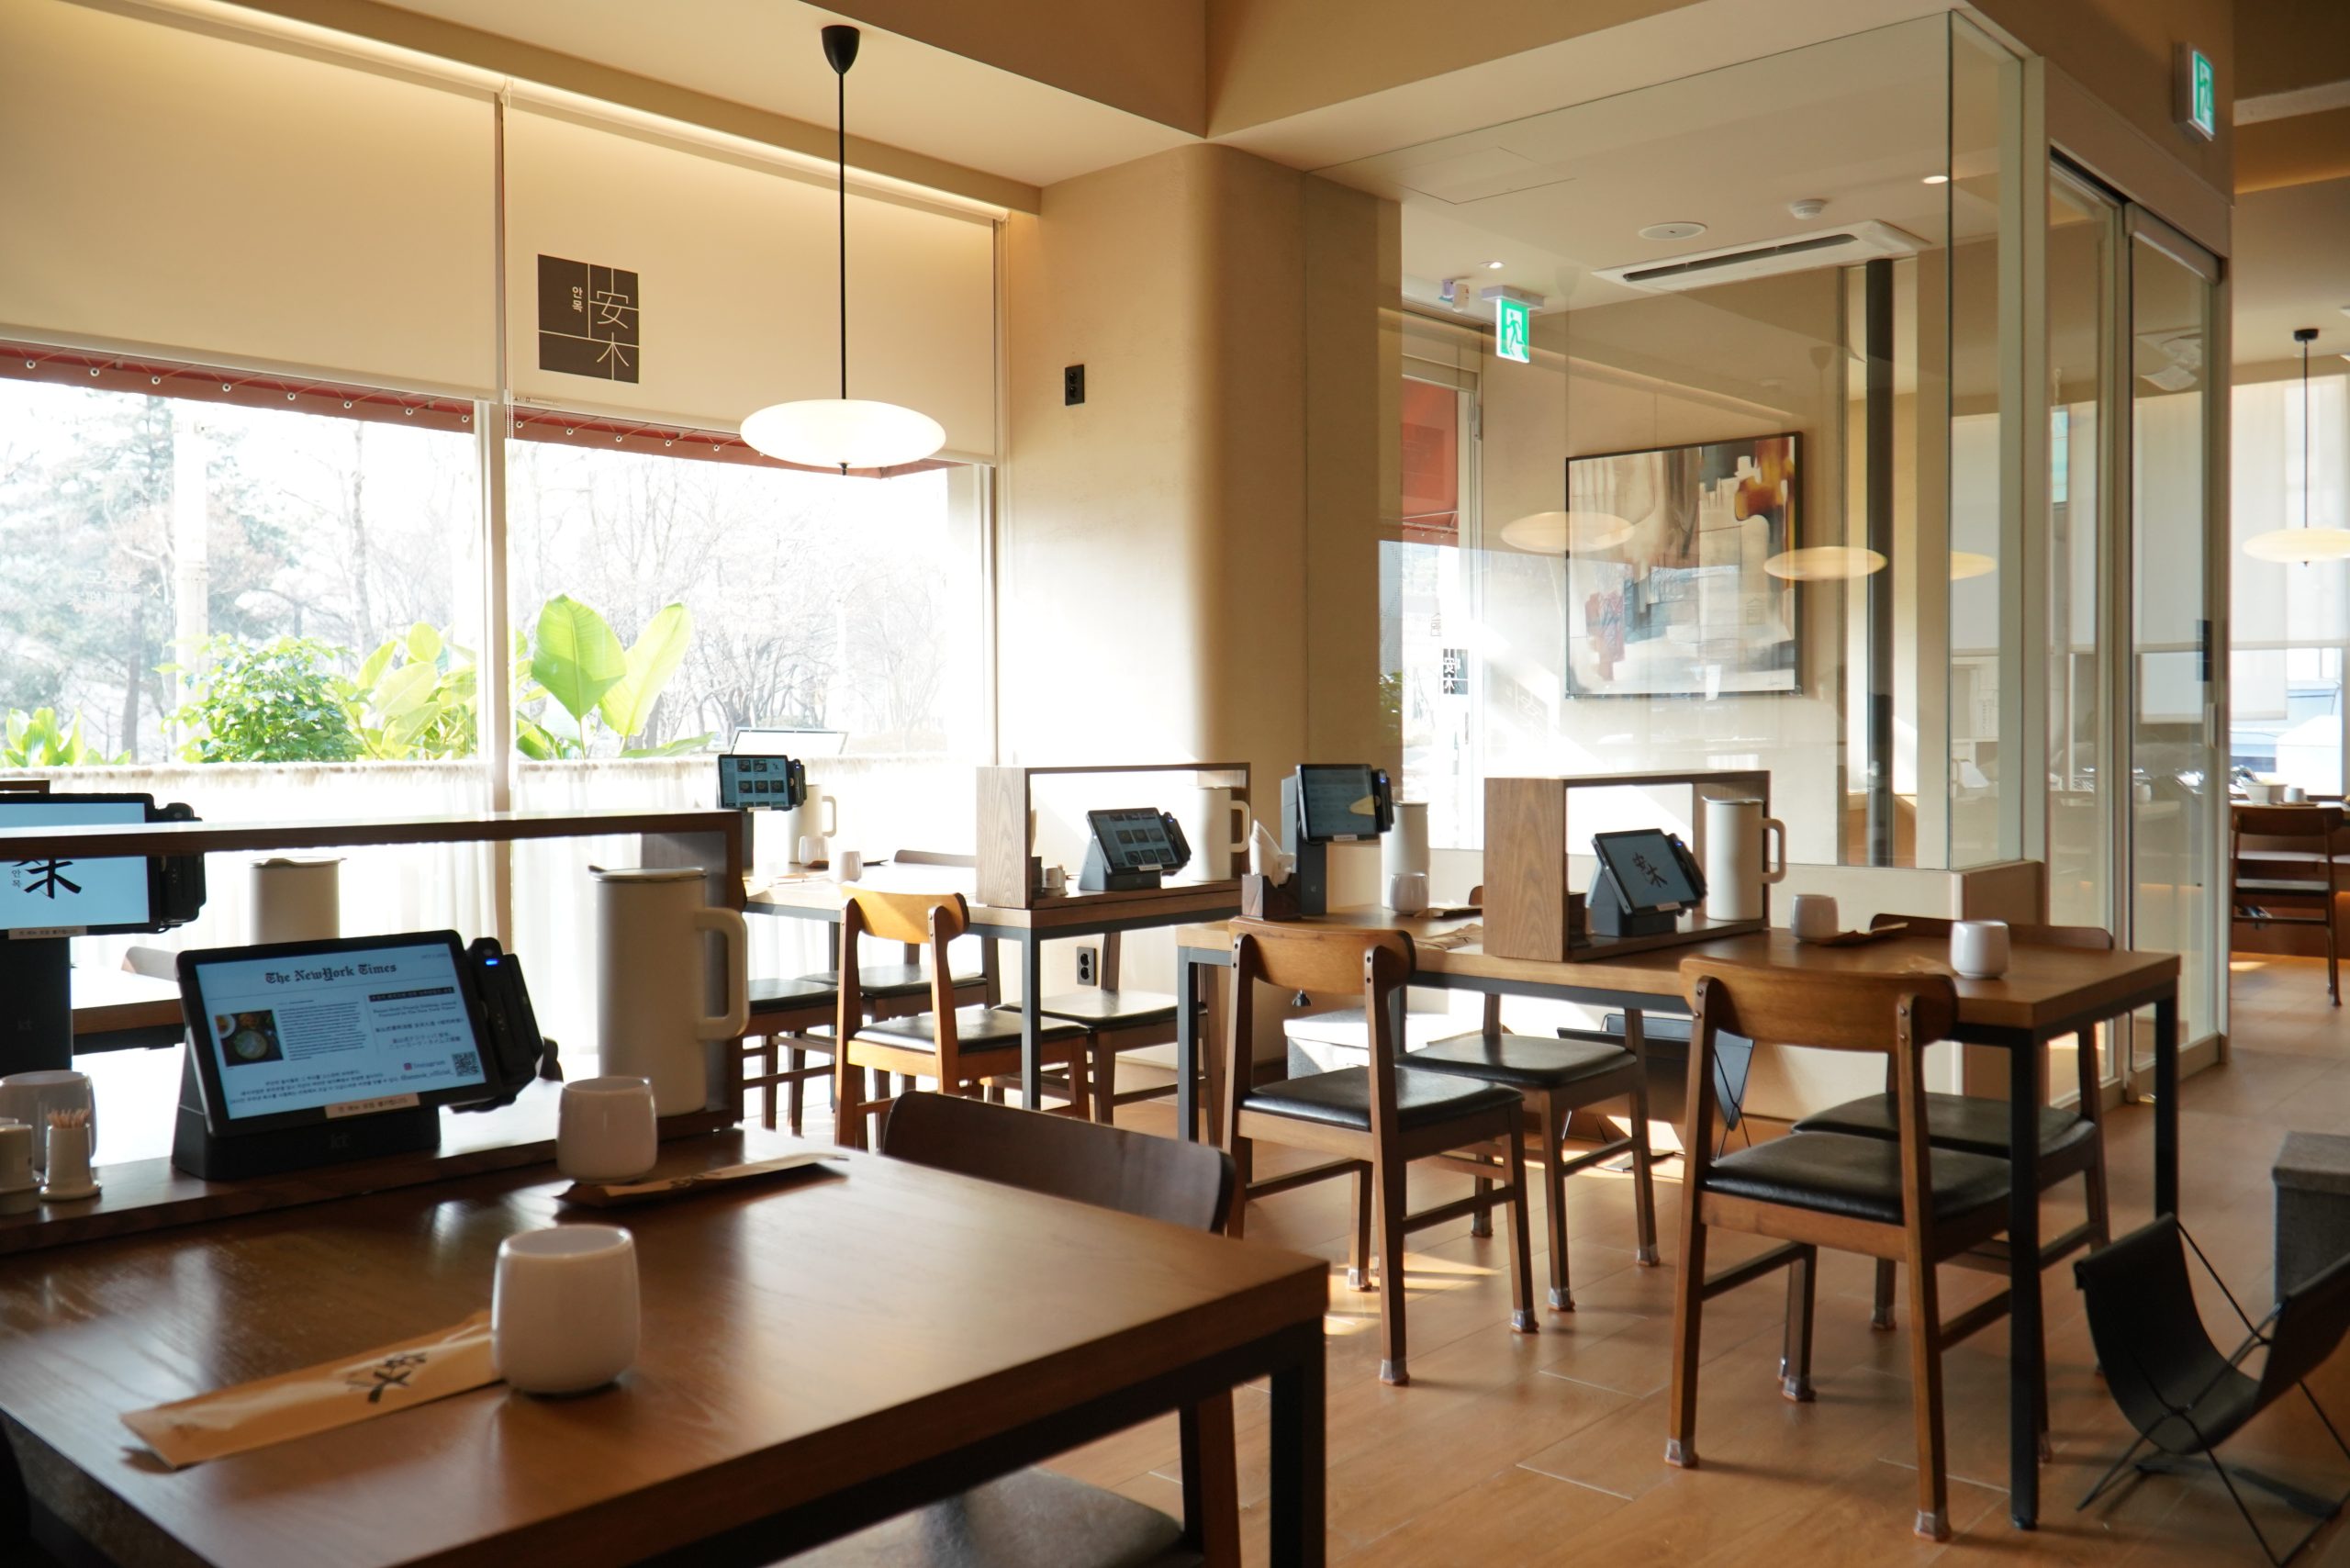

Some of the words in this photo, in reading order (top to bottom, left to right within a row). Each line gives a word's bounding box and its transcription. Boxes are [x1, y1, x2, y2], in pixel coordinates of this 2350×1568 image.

[571, 286, 584, 313] 안목
[596, 281, 631, 378] 安木
[264, 971, 291, 984] The
[358, 963, 397, 975] Times
